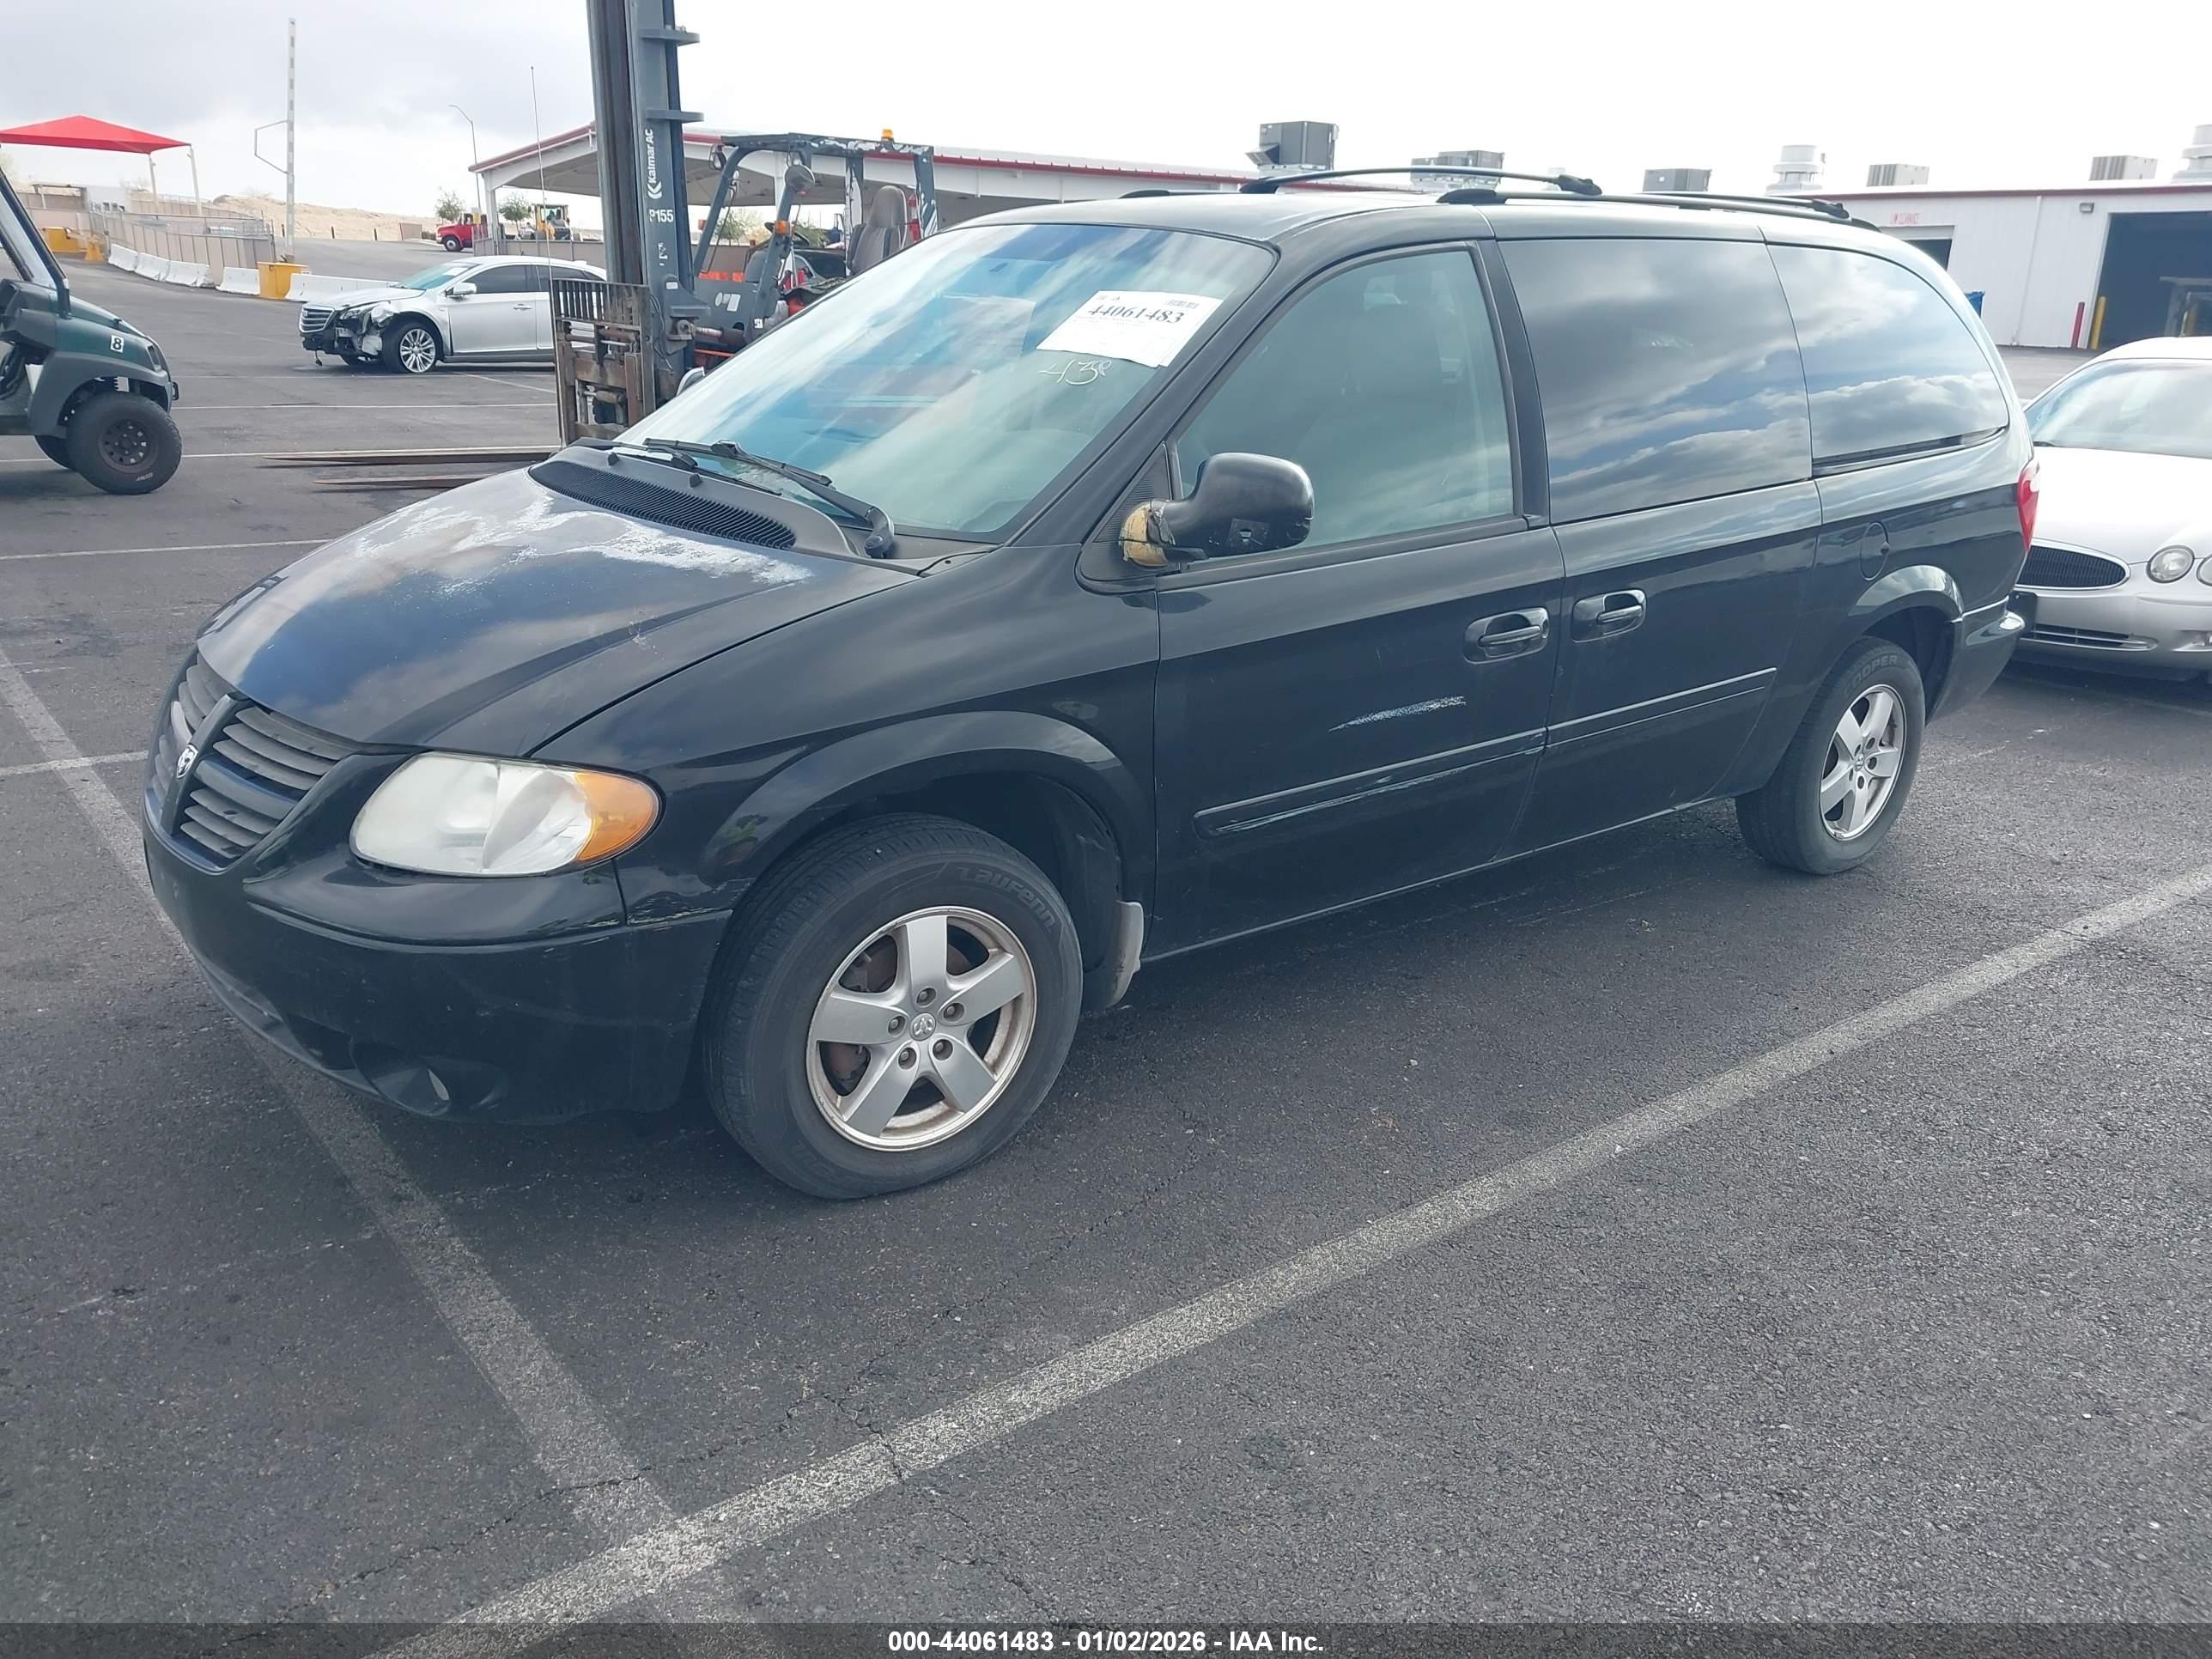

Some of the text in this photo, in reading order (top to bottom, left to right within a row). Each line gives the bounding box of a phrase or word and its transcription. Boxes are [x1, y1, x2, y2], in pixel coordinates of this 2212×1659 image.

[645, 129, 658, 184] Kalmar AC
[1088, 305, 1185, 324] 44061483
[112, 337, 122, 350] 8
